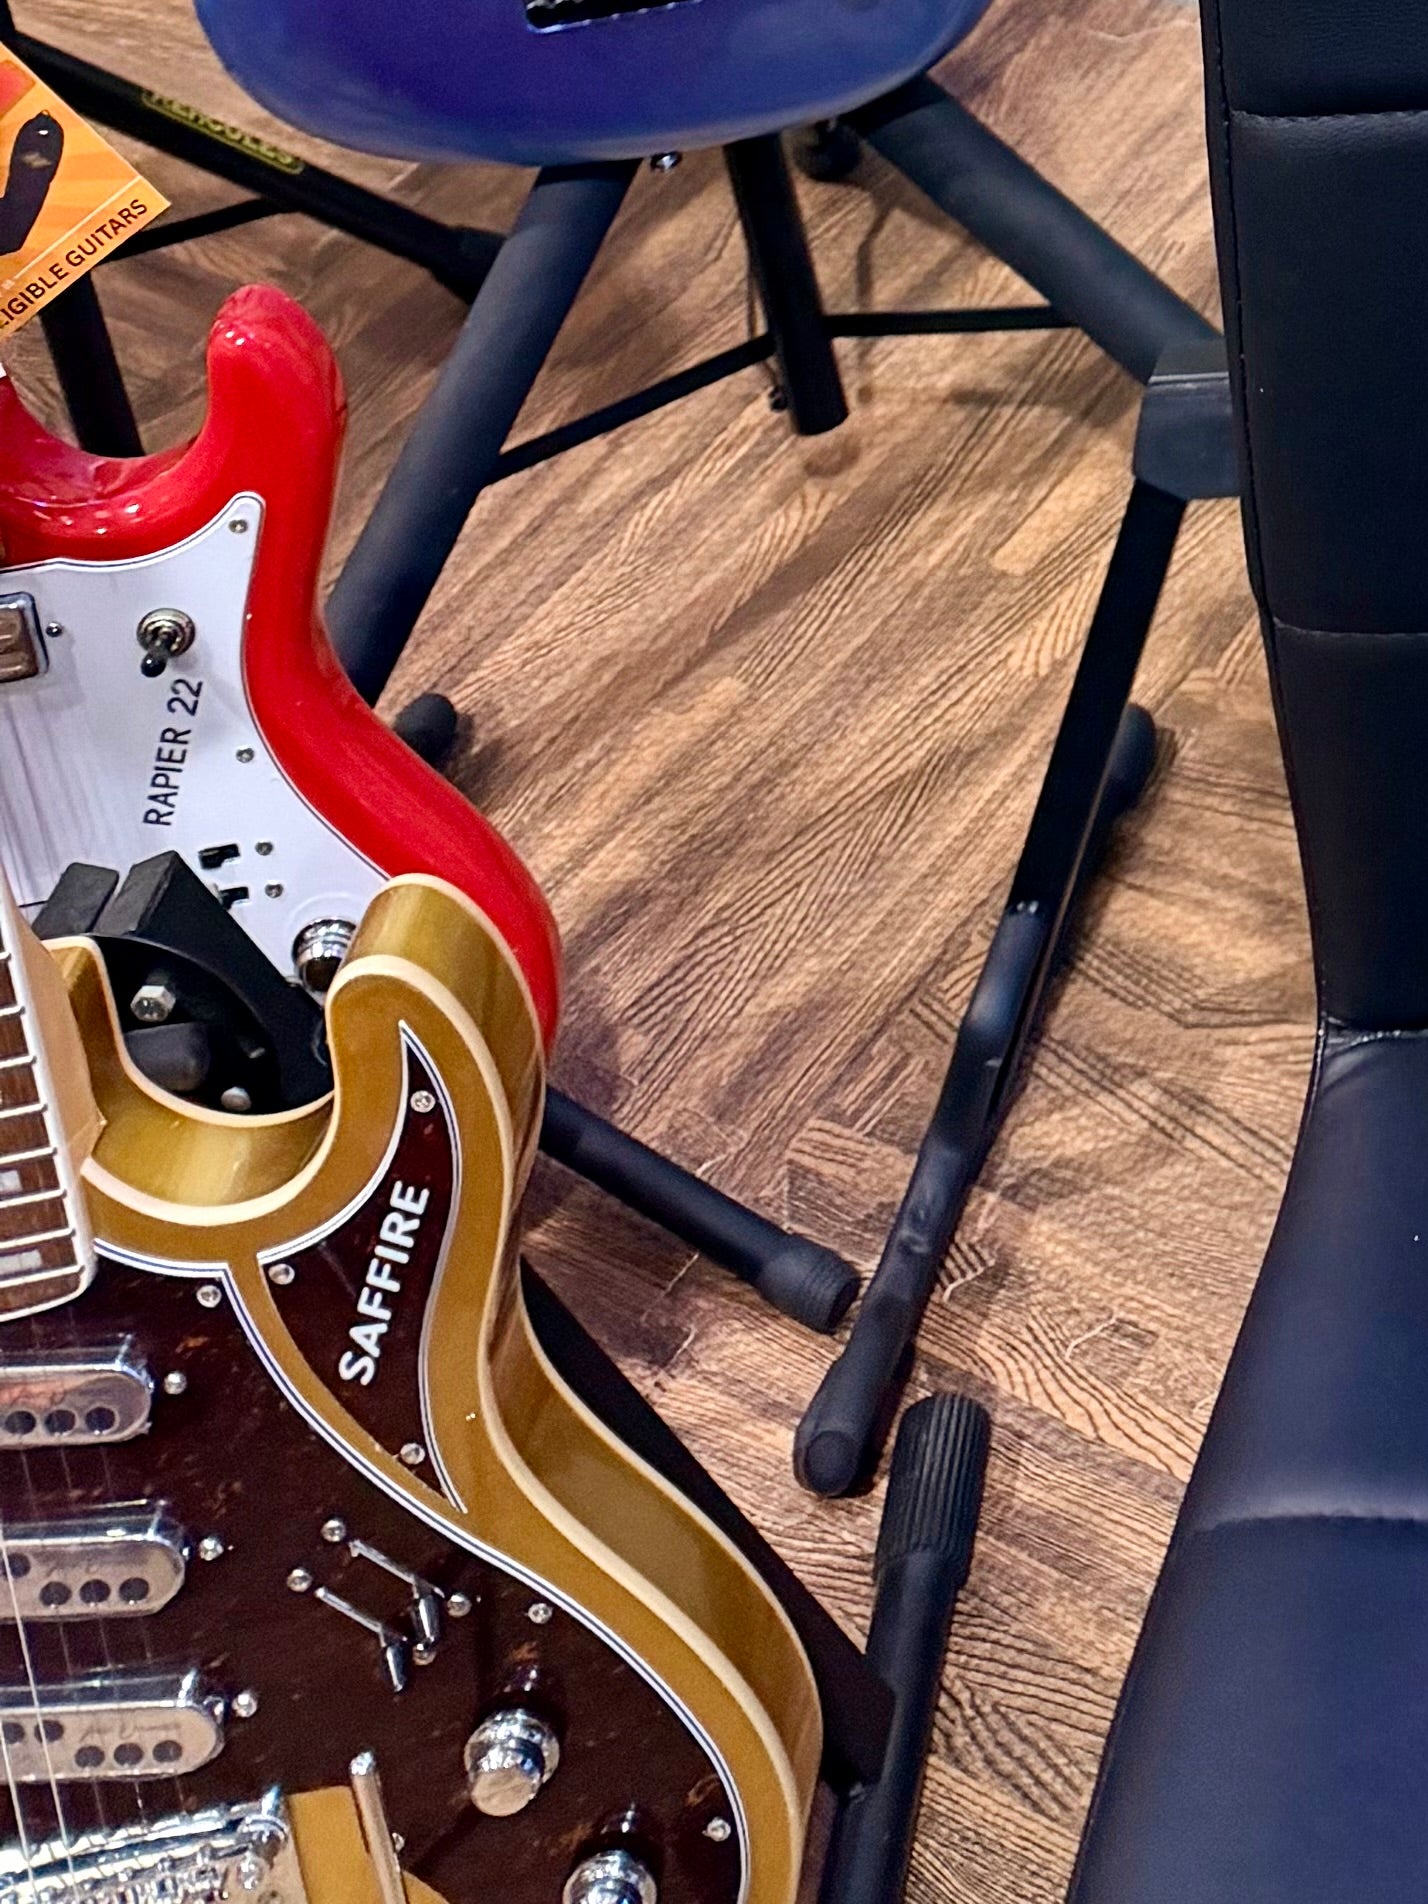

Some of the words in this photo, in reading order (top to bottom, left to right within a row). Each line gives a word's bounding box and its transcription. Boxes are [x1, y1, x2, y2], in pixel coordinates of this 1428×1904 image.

[0, 263, 70, 328] IGIBLE
[65, 199, 148, 267] GUITARS
[142, 725, 192, 827] RAPIER
[167, 678, 204, 717] 22
[338, 1180, 430, 1386] SAFFIRE
